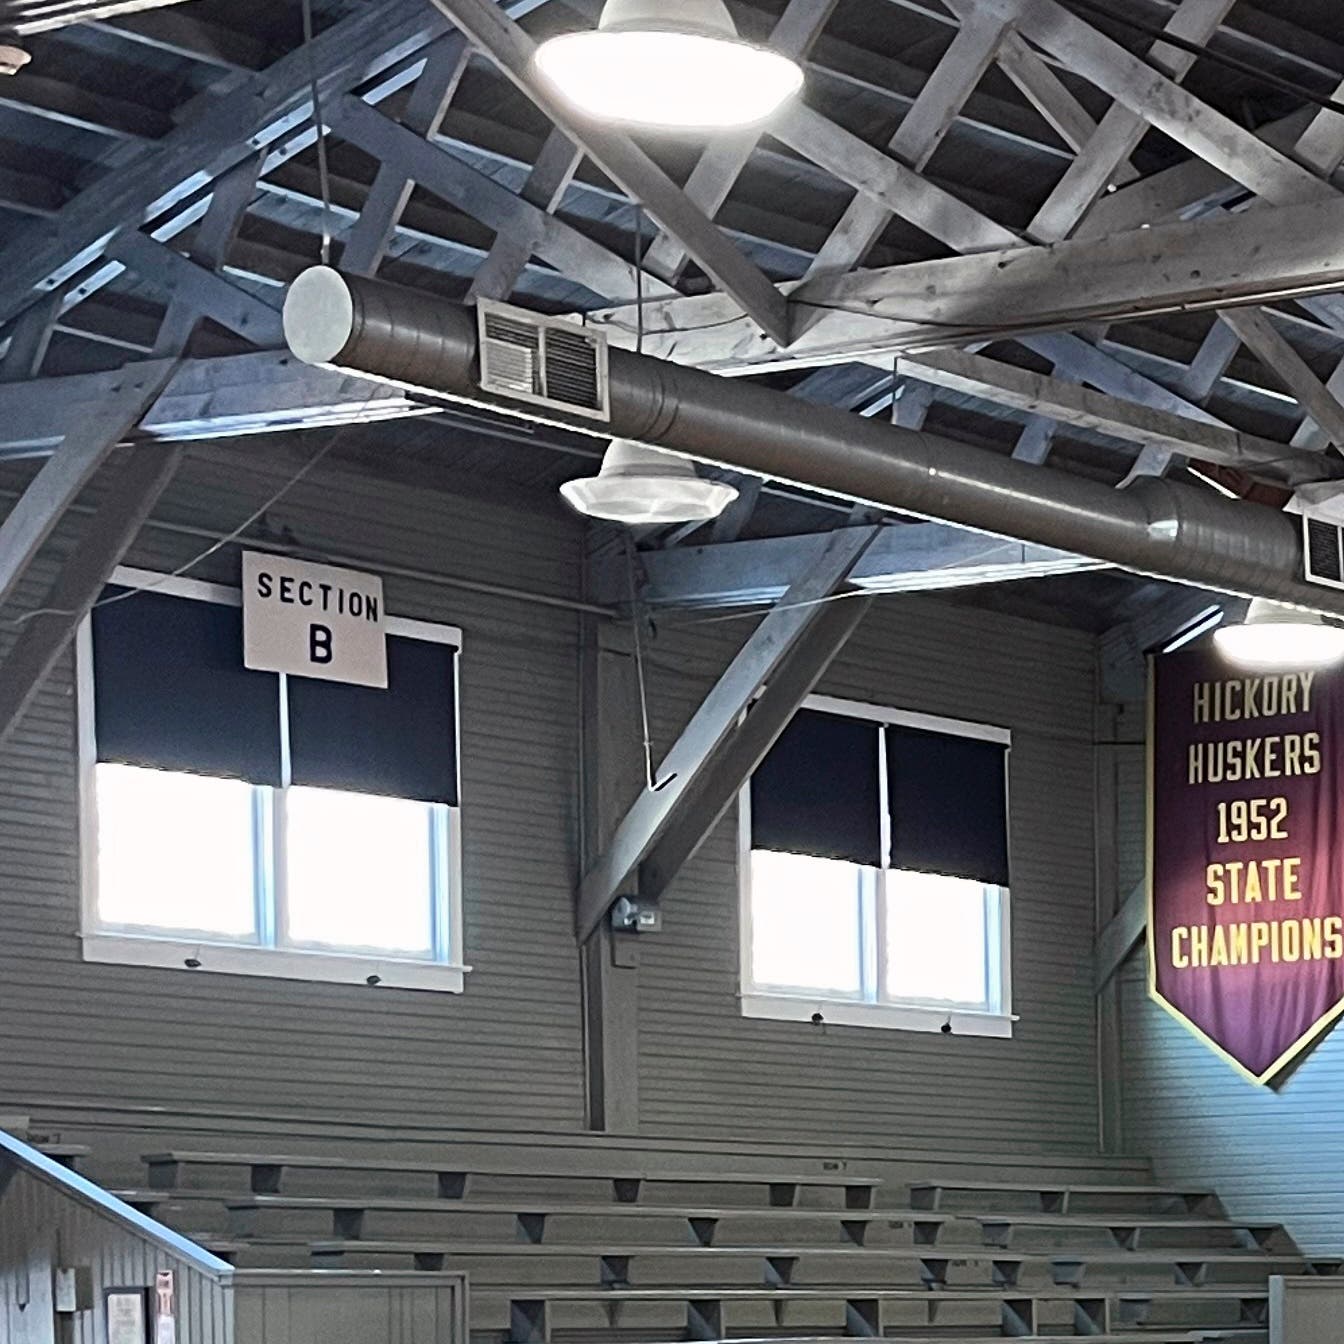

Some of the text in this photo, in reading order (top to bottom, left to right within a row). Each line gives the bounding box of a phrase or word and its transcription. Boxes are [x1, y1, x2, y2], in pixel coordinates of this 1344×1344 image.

[258, 572, 378, 622] SECTION
[310, 623, 333, 664] B
[1193, 671, 1315, 723] HICKORY
[1188, 732, 1321, 784] HUSKERS
[1216, 797, 1289, 843] 1952
[1206, 857, 1302, 906] STATE
[1171, 916, 1344, 969] CHAMPIONS
